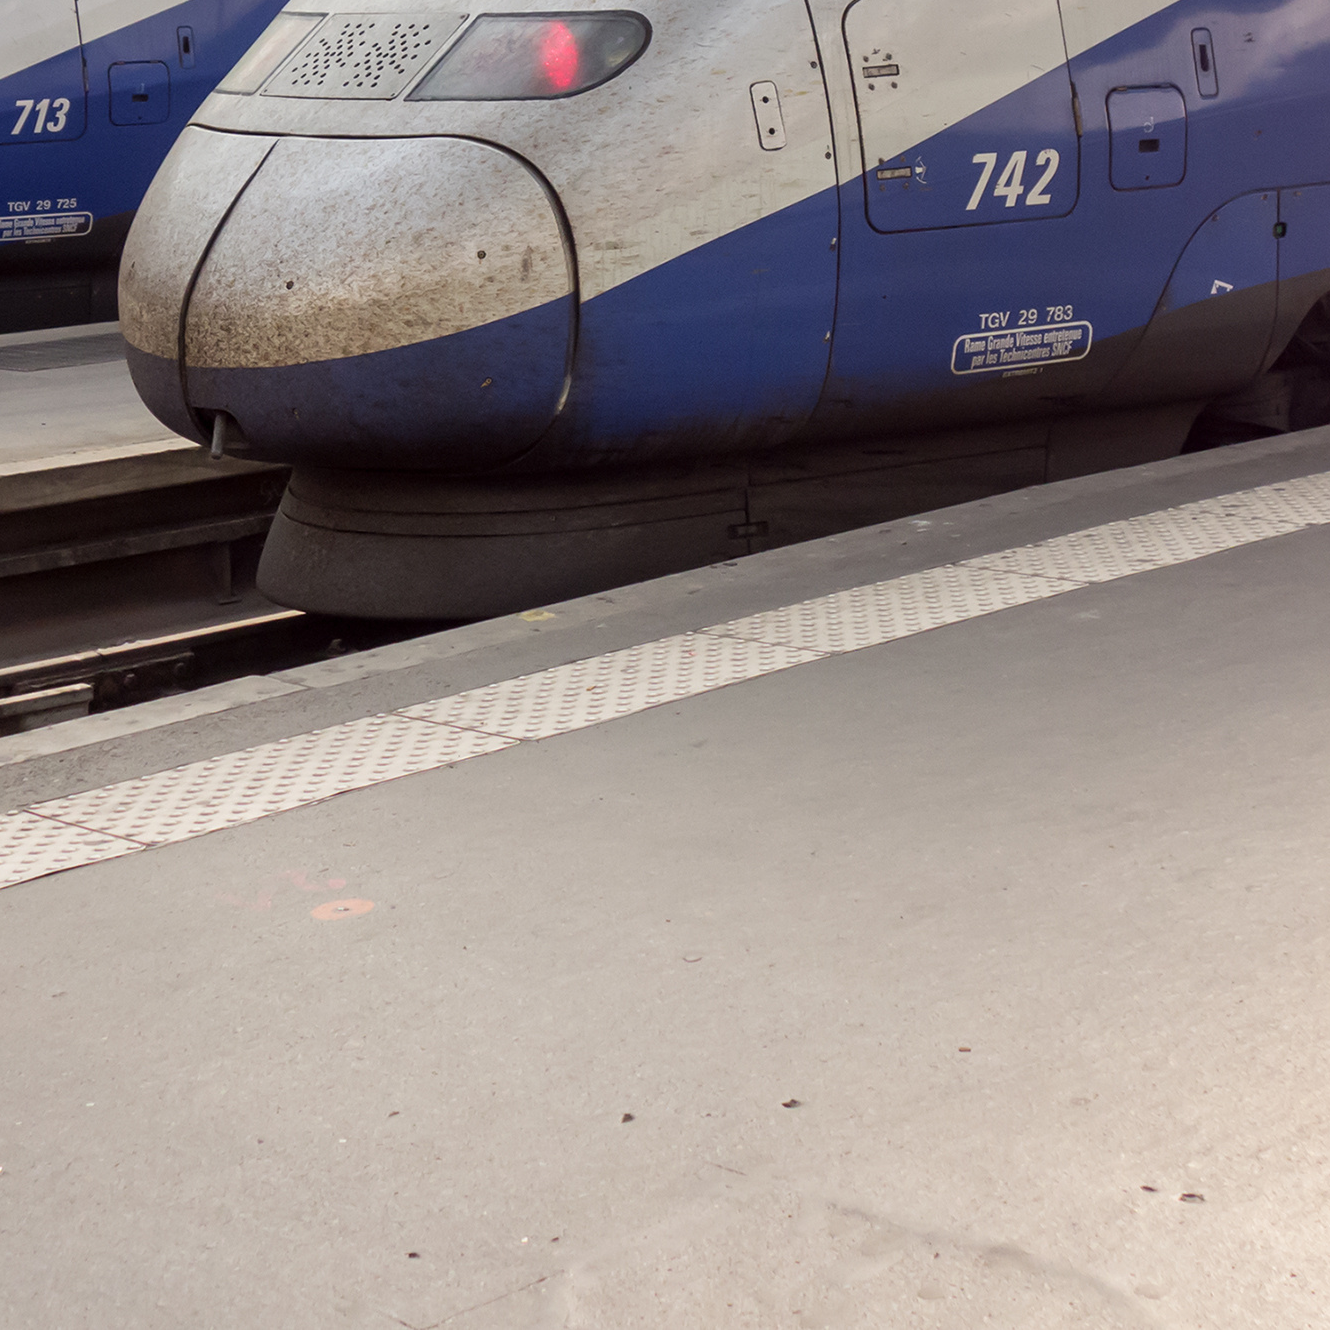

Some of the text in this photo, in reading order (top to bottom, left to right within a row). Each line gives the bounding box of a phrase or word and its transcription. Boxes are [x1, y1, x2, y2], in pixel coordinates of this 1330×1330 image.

[11, 98, 70, 135] 713
[966, 148, 1060, 211] 742
[7, 198, 77, 212] TGV 29 725
[979, 304, 1073, 329] TGV 29 783
[964, 328, 1083, 353] Rame Grande Vitesse entretenue
[971, 341, 1074, 369] par les Technicentres SNCF
